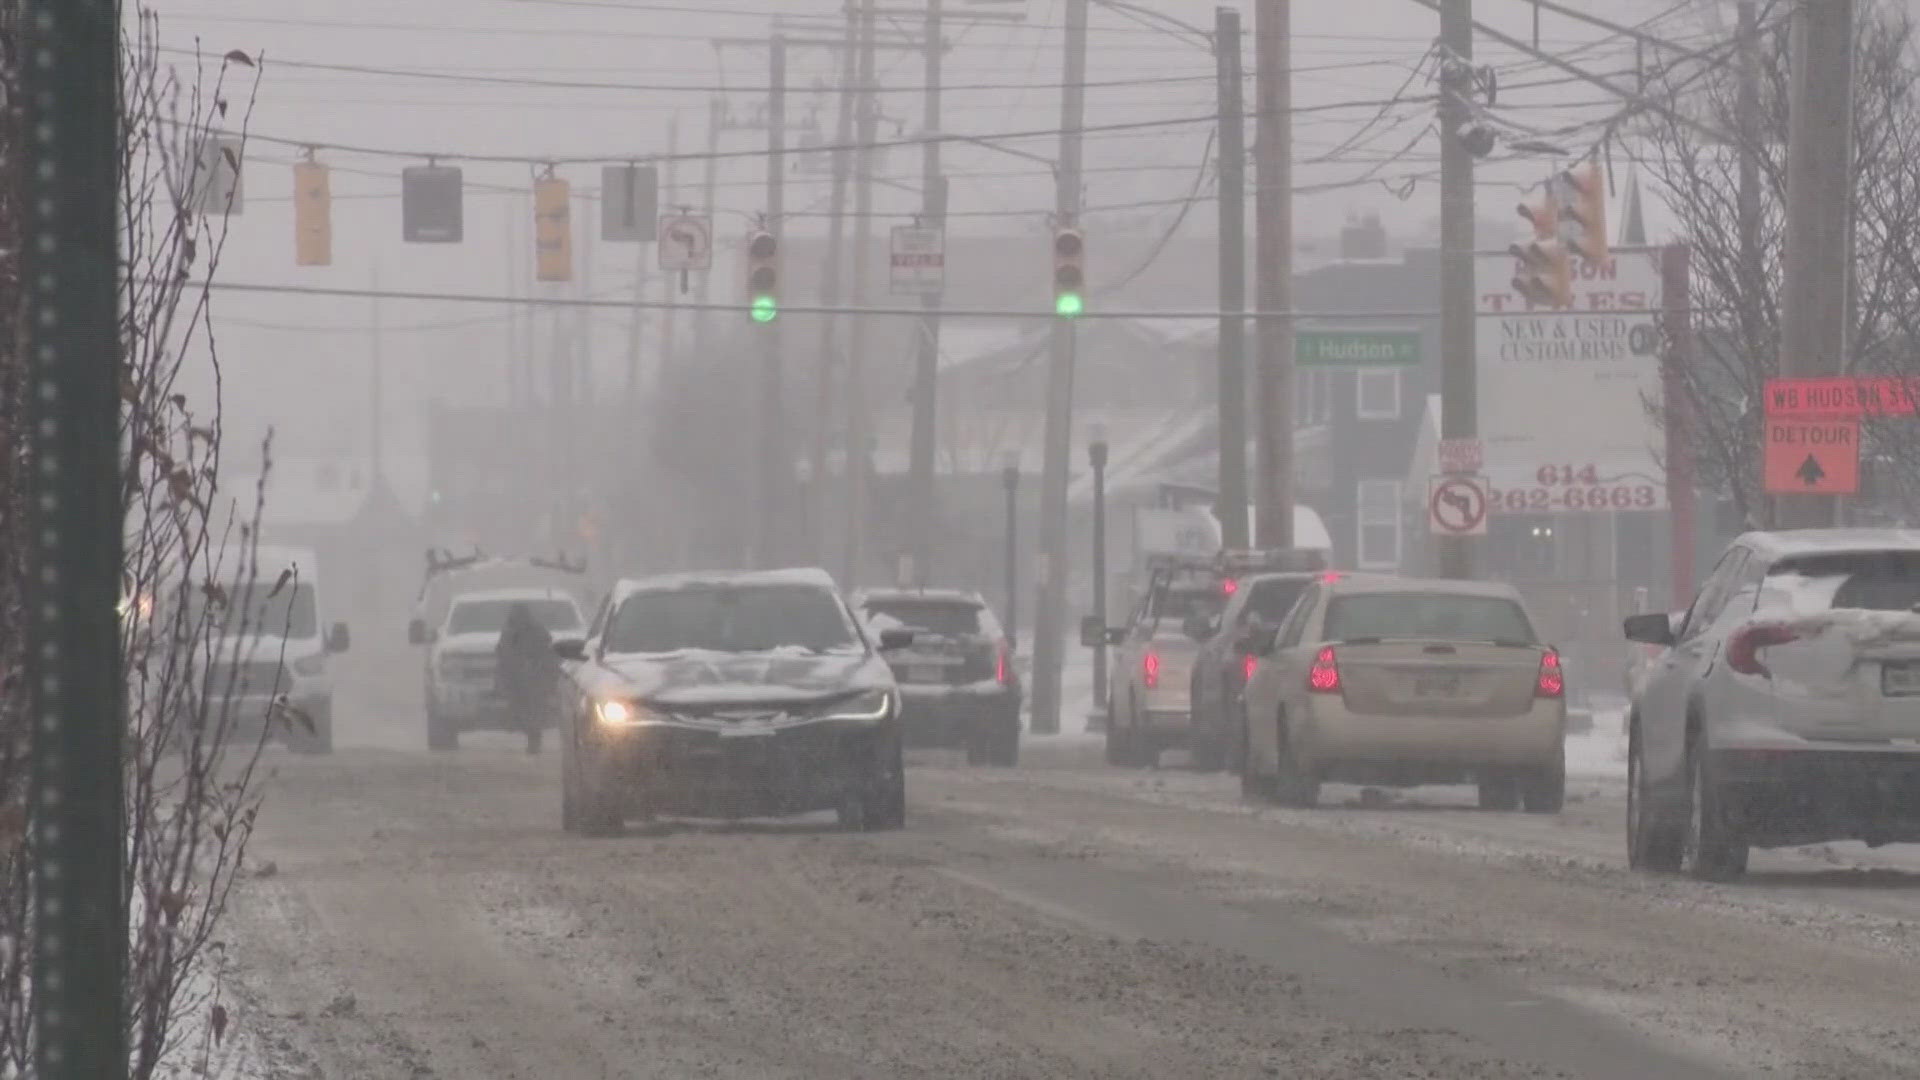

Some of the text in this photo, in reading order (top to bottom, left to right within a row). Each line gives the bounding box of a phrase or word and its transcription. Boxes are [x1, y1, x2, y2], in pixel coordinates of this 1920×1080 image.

[1482, 291, 1646, 311] TES
[1501, 318, 1627, 339] NEW & USED
[1318, 340, 1395, 358] Hudson
[1501, 340, 1626, 362] CUSTOM RIMS
[1773, 386, 1798, 408] WB
[1772, 425, 1851, 446] DETOUR
[1536, 464, 1599, 487] 614
[1488, 485, 1656, 511] 262-6663
